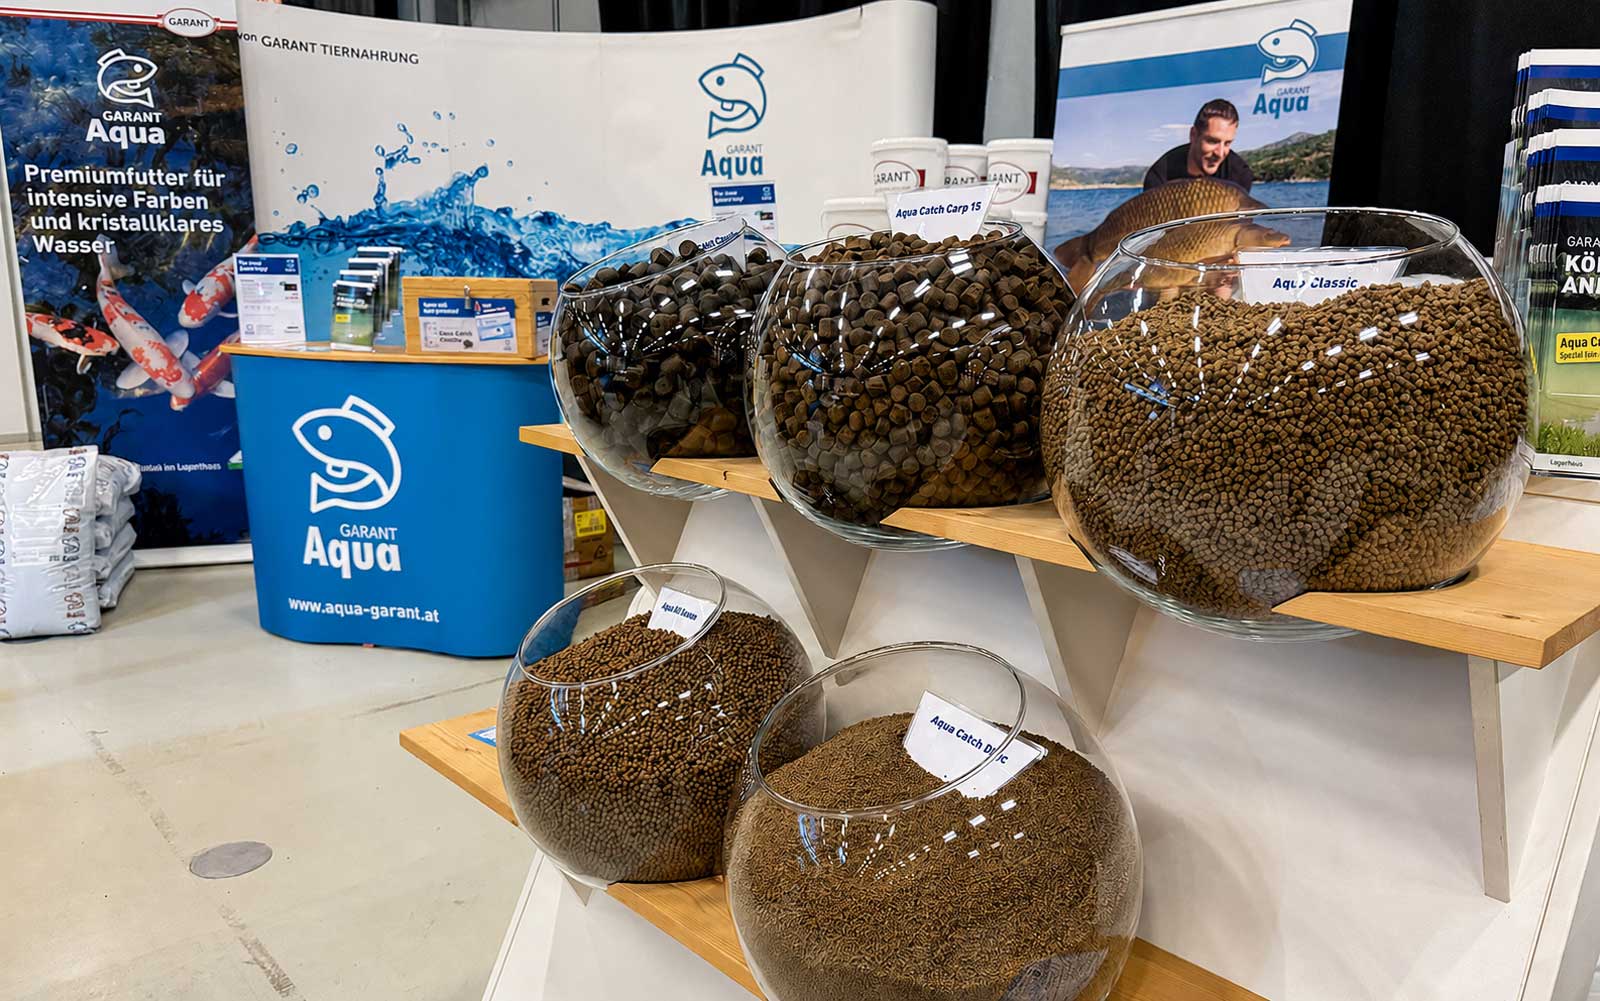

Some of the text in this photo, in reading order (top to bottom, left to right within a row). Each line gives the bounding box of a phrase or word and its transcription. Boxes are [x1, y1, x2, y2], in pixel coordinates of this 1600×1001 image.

[168, 17, 210, 28] GARANT
[236, 32, 420, 65] von GARANT TIERNAHRUNG
[1276, 86, 1311, 97] GARANT
[1252, 93, 1310, 119] Aqua
[102, 110, 162, 123] GARANT
[86, 118, 166, 149] Aqua
[727, 144, 763, 155] GARANT
[701, 149, 764, 180] Aqua
[24, 164, 226, 188] Premiumfutter für
[873, 171, 911, 184] ARANT
[26, 188, 209, 210] intensive Farben
[896, 201, 982, 219] Aqua Catch Carp 15
[31, 210, 224, 234] und kristallklares
[34, 235, 115, 254] Wasser
[1565, 251, 1600, 273] KÖ
[1310, 276, 1359, 289] Classic
[1560, 275, 1600, 294] AN
[1560, 336, 1600, 350] Aqua C
[1550, 459, 1584, 467] Lagerhaus
[339, 523, 398, 540] GARANT
[302, 526, 402, 579] Aqua
[288, 598, 440, 623] www.aqua-garant.at
[930, 715, 956, 734] Aqua
[955, 728, 983, 750] Catch
